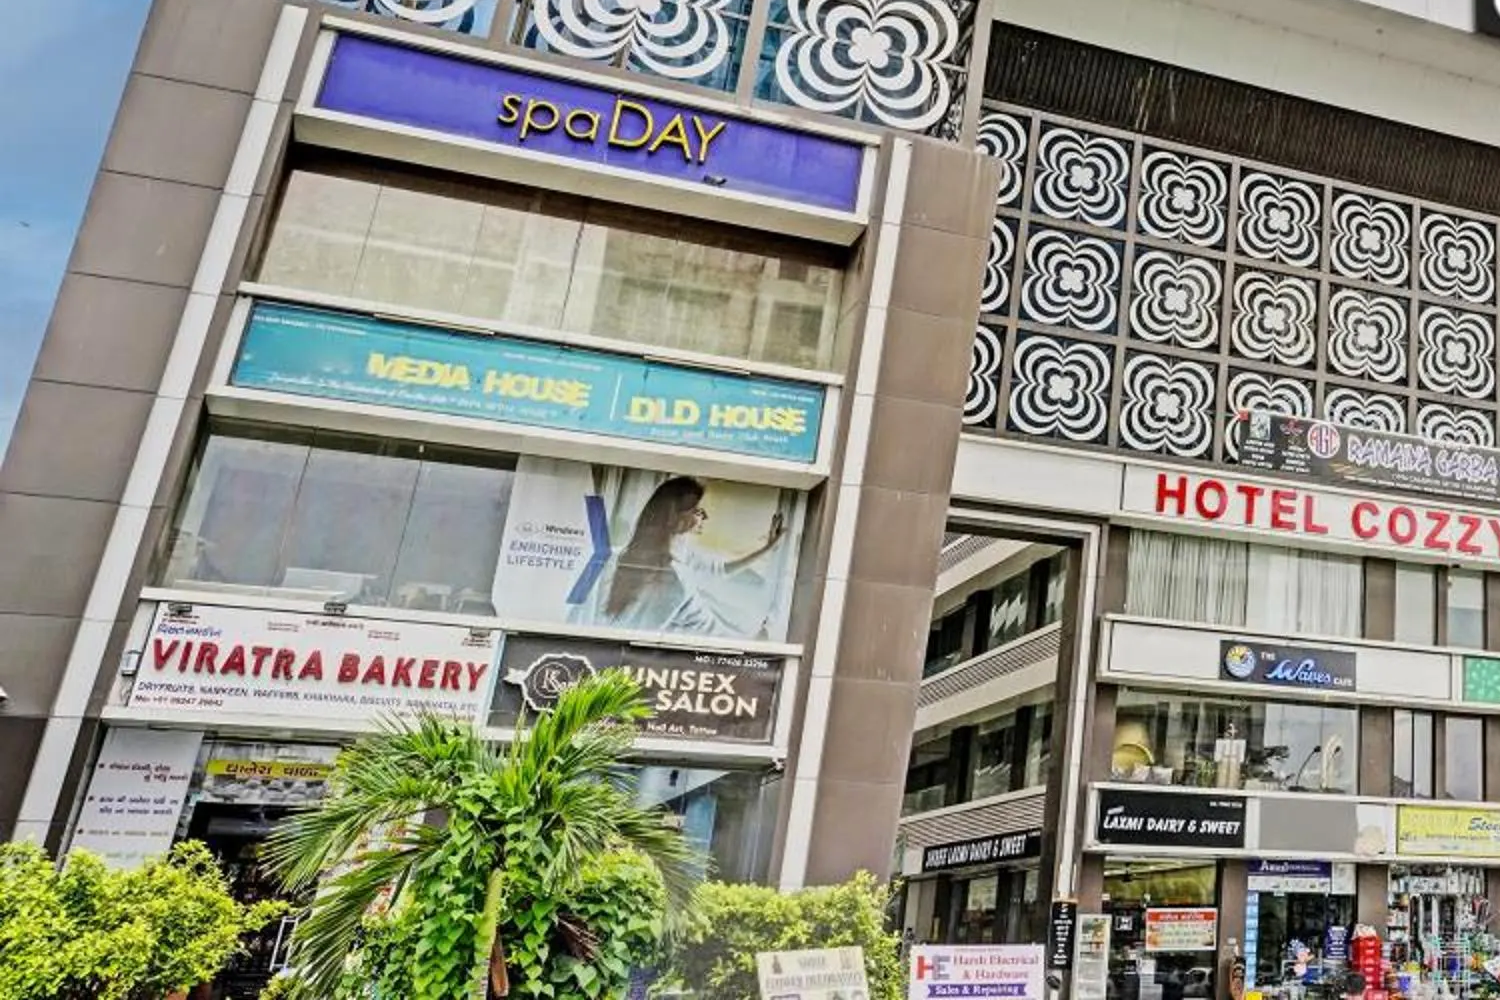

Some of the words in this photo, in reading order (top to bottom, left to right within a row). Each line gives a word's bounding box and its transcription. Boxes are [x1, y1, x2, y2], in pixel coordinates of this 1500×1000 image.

[367, 352, 471, 391] MEDIA
[484, 369, 594, 409] HOUSE
[707, 402, 808, 435] HOUSE
[1156, 473, 1329, 534] HOTEL
[506, 555, 576, 571] LIFESTYLE
[509, 540, 582, 557] ENRICHING
[152, 637, 324, 683] VIRATRA
[336, 653, 490, 693] BAKERY
[655, 688, 759, 719] SALON
[1103, 816, 1144, 832] LAXMI
[1146, 817, 1187, 834] DAIRY
[1188, 820, 1197, 834] &
[1200, 820, 1241, 836] SWEET
